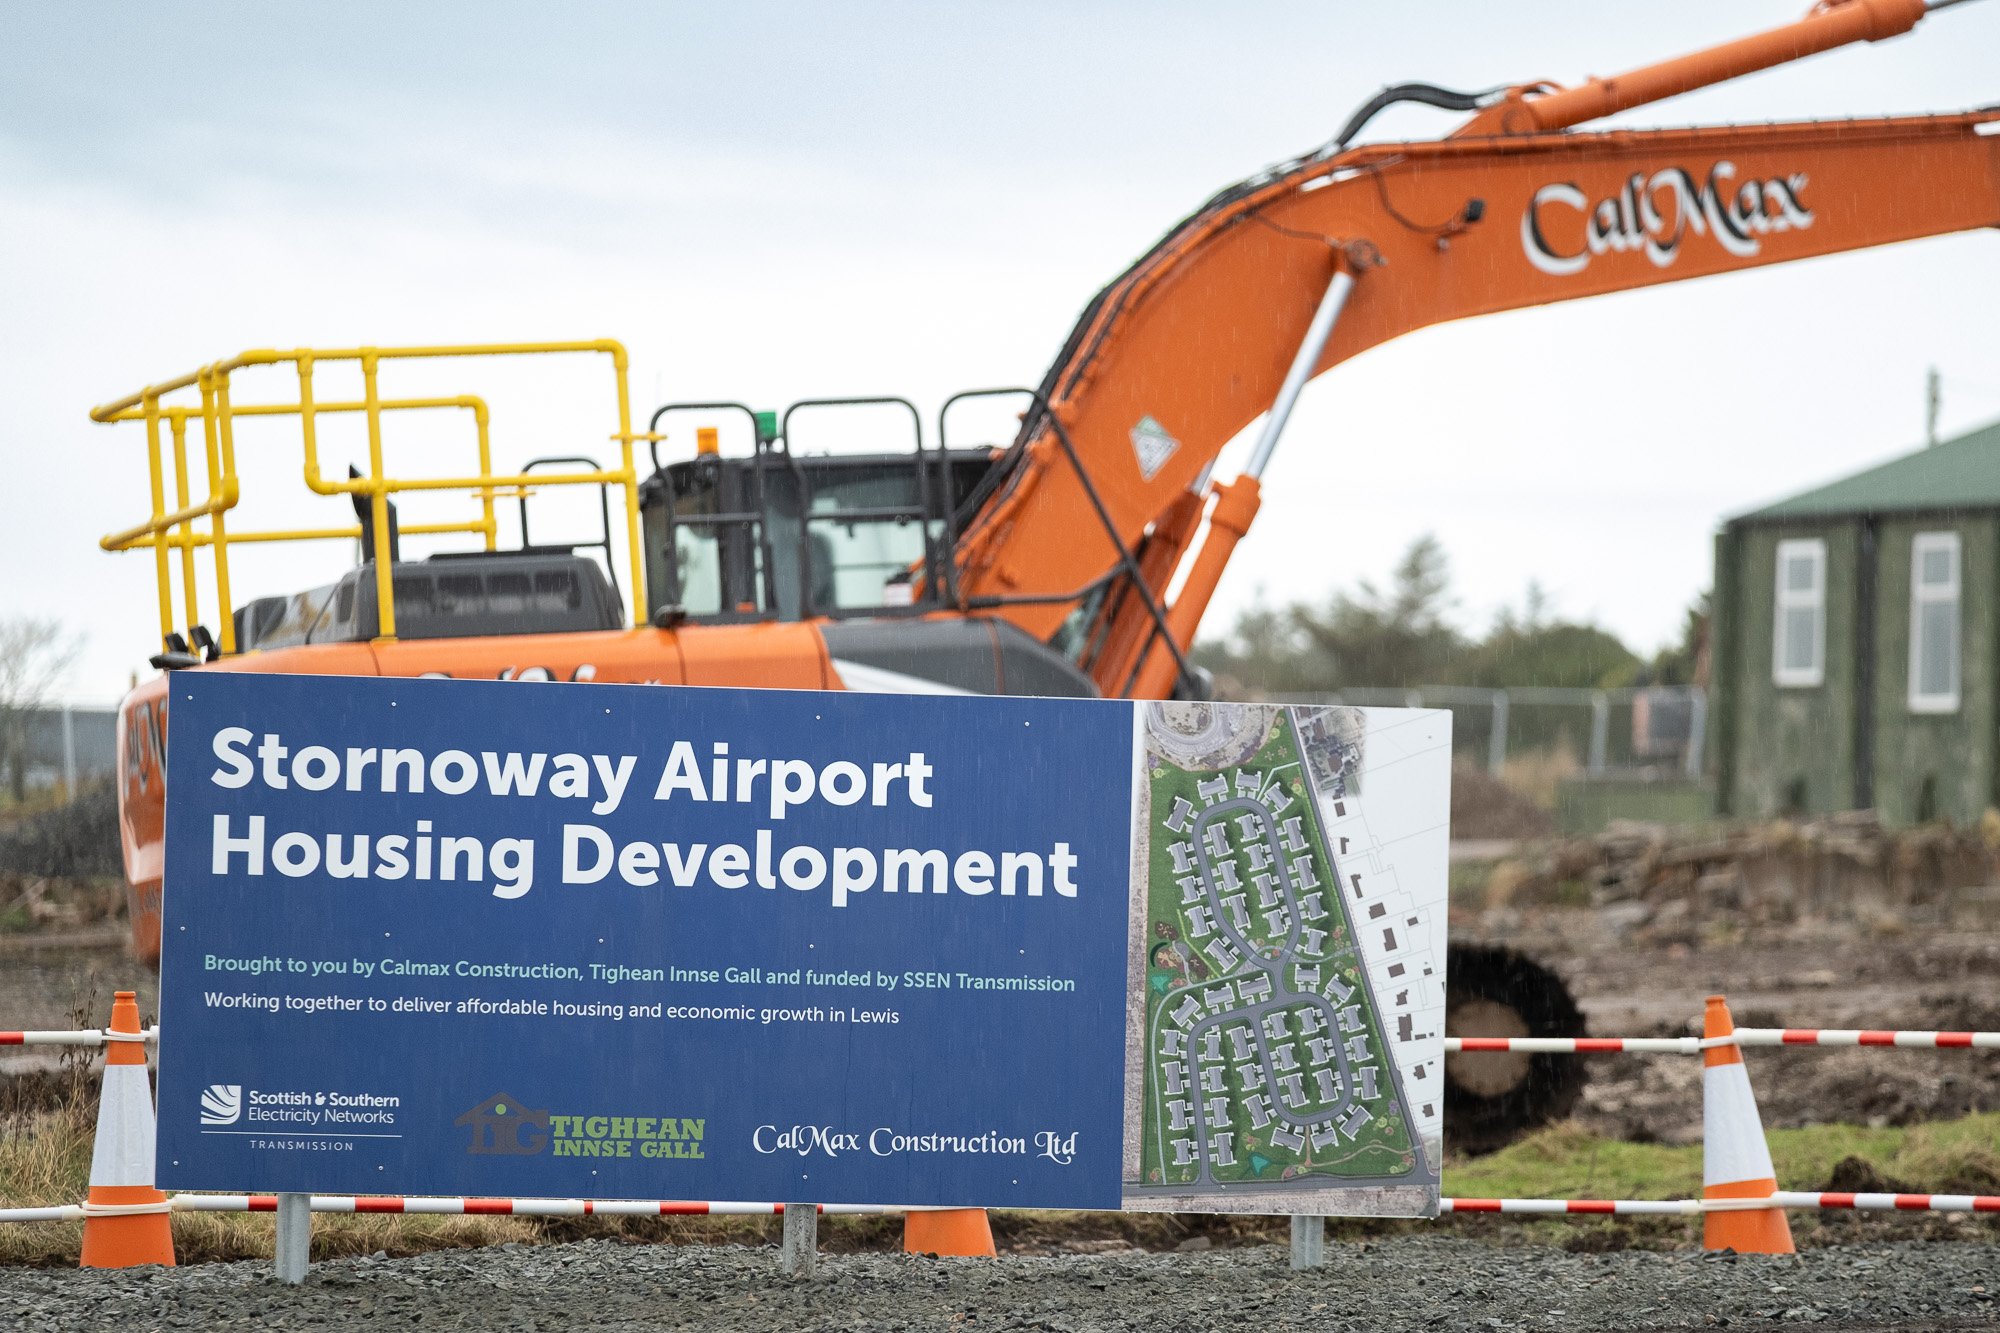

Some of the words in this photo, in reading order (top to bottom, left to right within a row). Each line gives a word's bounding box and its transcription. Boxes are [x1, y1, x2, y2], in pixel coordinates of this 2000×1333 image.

[1520, 160, 1815, 276] CalMax
[210, 726, 638, 815] Stornoway
[653, 740, 934, 820] Airport
[211, 814, 535, 900] Housing
[561, 823, 1078, 908] Development
[204, 954, 283, 976] Brought
[286, 957, 308, 973] to
[311, 961, 347, 977] you
[352, 957, 376, 979] by
[379, 958, 451, 977] Calmax
[454, 960, 584, 982] Construction,
[588, 963, 664, 985] Tighean
[670, 965, 720, 983] Innse
[724, 966, 762, 985] Gall
[765, 968, 801, 985] and
[805, 969, 871, 987] funded
[876, 970, 900, 992] by
[903, 971, 951, 989] SSEN
[955, 972, 1076, 992] Transmission
[204, 991, 280, 1013] Working
[284, 994, 364, 1014] together
[367, 996, 387, 1012] to
[391, 996, 453, 1014] deliver
[456, 997, 548, 1016] affordable
[552, 1000, 624, 1021] housing
[628, 1002, 662, 1018] and
[666, 1004, 756, 1021] economic
[760, 1006, 824, 1025] growth
[829, 1006, 845, 1023] in
[851, 1007, 900, 1024] Lewis
[249, 1090, 312, 1106] Scottish
[315, 1091, 326, 1106] &
[329, 1092, 399, 1107] Southern
[248, 1106, 319, 1126] Electricity
[325, 1109, 394, 1124] Networks
[549, 1115, 706, 1141] TIGHEAN
[250, 1140, 353, 1151] TRANSMISSION
[553, 1139, 632, 1158] INNSE
[640, 1141, 705, 1159] GALL
[752, 1125, 861, 1157] CalMax
[869, 1127, 1027, 1156] Construction
[1034, 1131, 1079, 1165] Ltd
